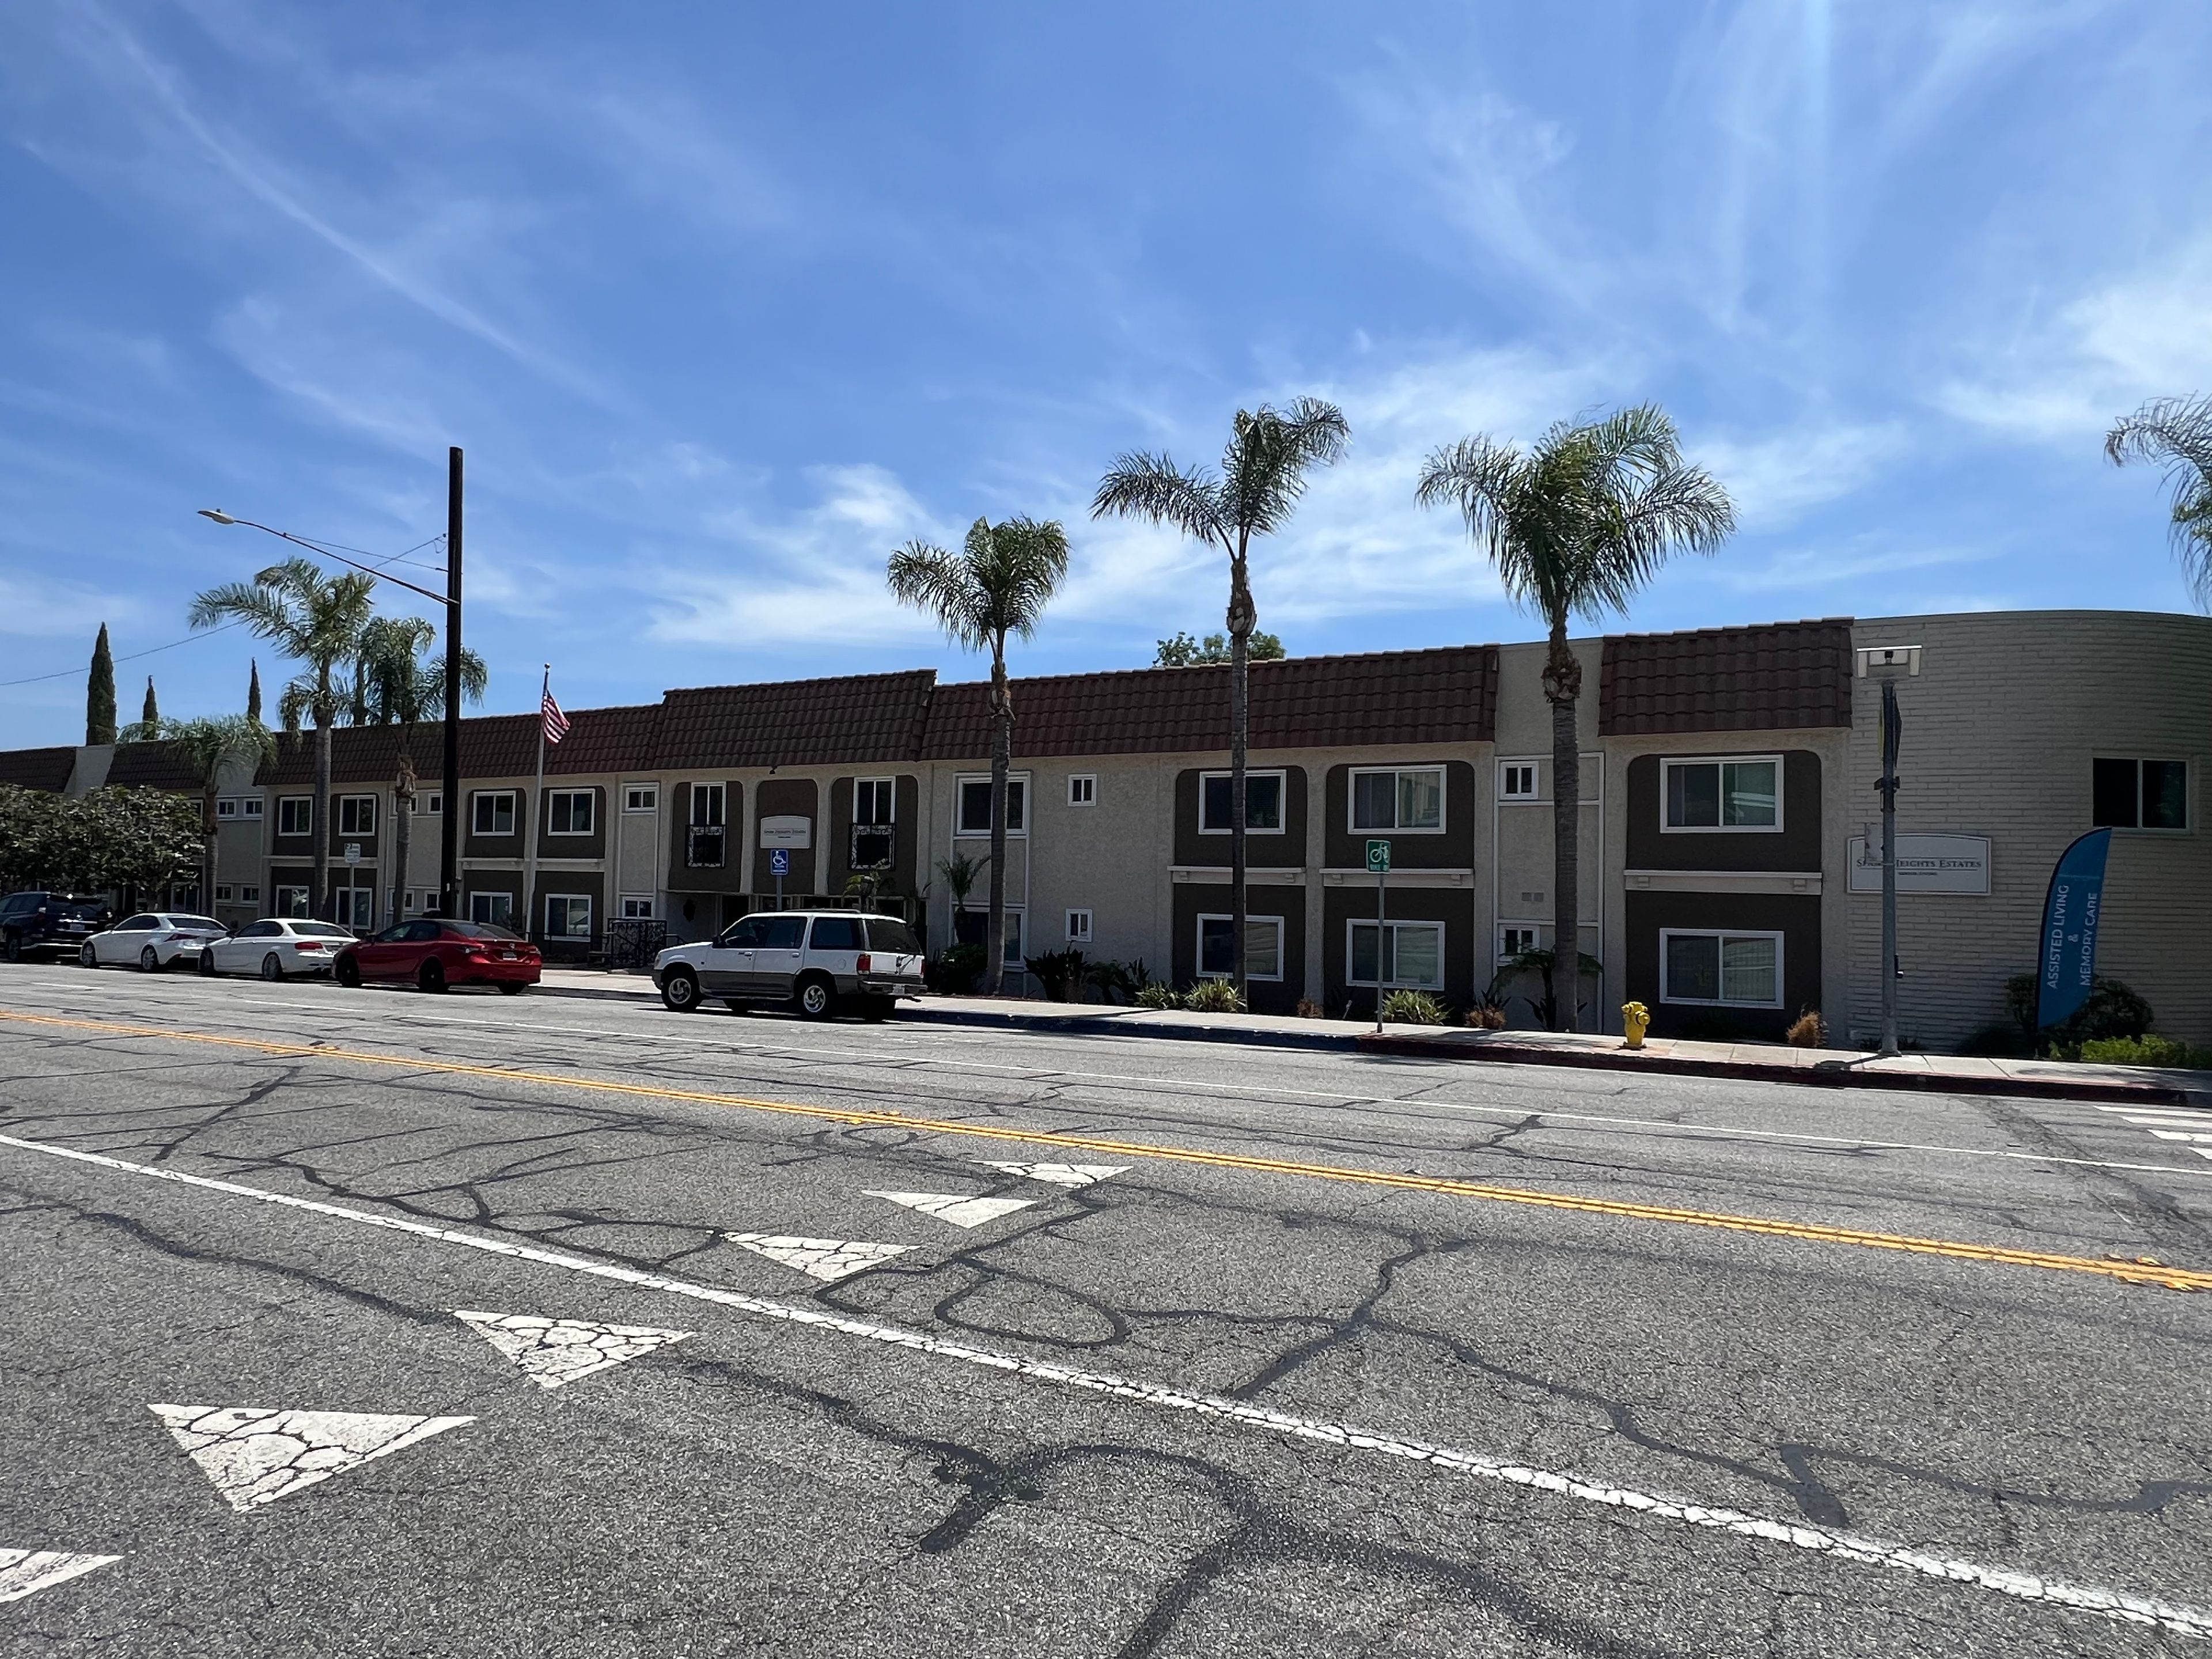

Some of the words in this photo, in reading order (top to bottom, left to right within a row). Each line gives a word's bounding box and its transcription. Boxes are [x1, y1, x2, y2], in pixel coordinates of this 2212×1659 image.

[1939, 859, 1982, 868] ESTATES
[2053, 884, 2070, 926] LIVING
[2085, 892, 2098, 927] CARE
[2067, 933, 2079, 942] &
[2046, 929, 2063, 990] ASSISTED
[2079, 929, 2093, 987] MEMORY
